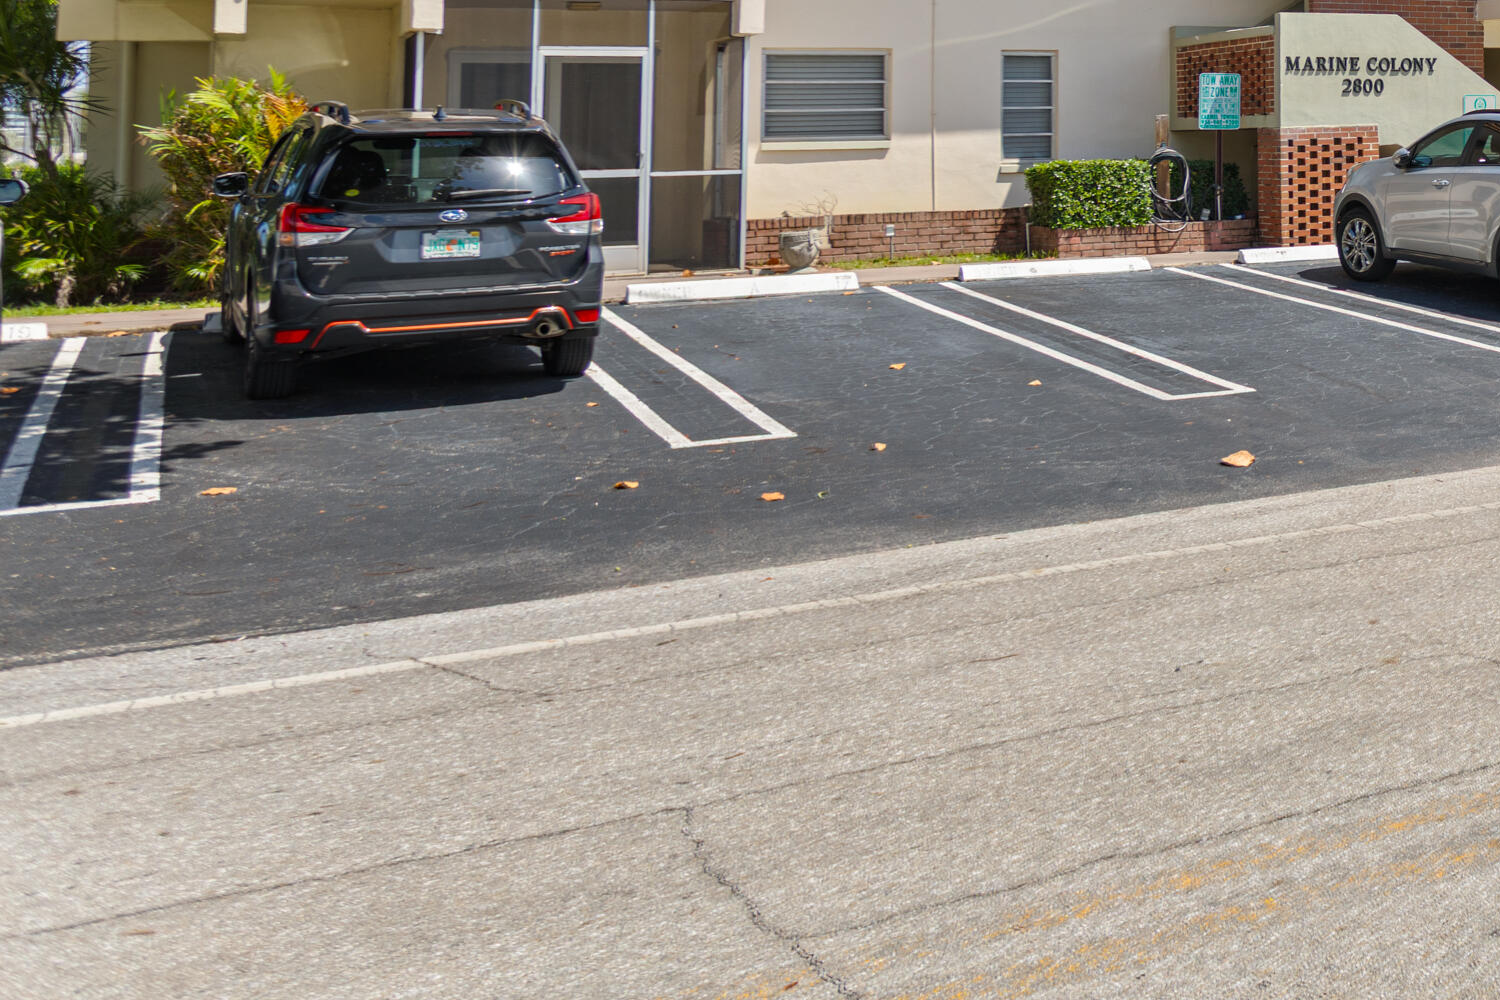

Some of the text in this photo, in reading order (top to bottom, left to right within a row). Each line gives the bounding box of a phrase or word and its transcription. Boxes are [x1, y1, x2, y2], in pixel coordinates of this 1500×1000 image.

[1285, 56, 1437, 74] MARINE COLONY
[1202, 75, 1238, 86] TOW AWAY
[1342, 78, 1384, 95] 2800
[1211, 87, 1229, 97] ZONE
